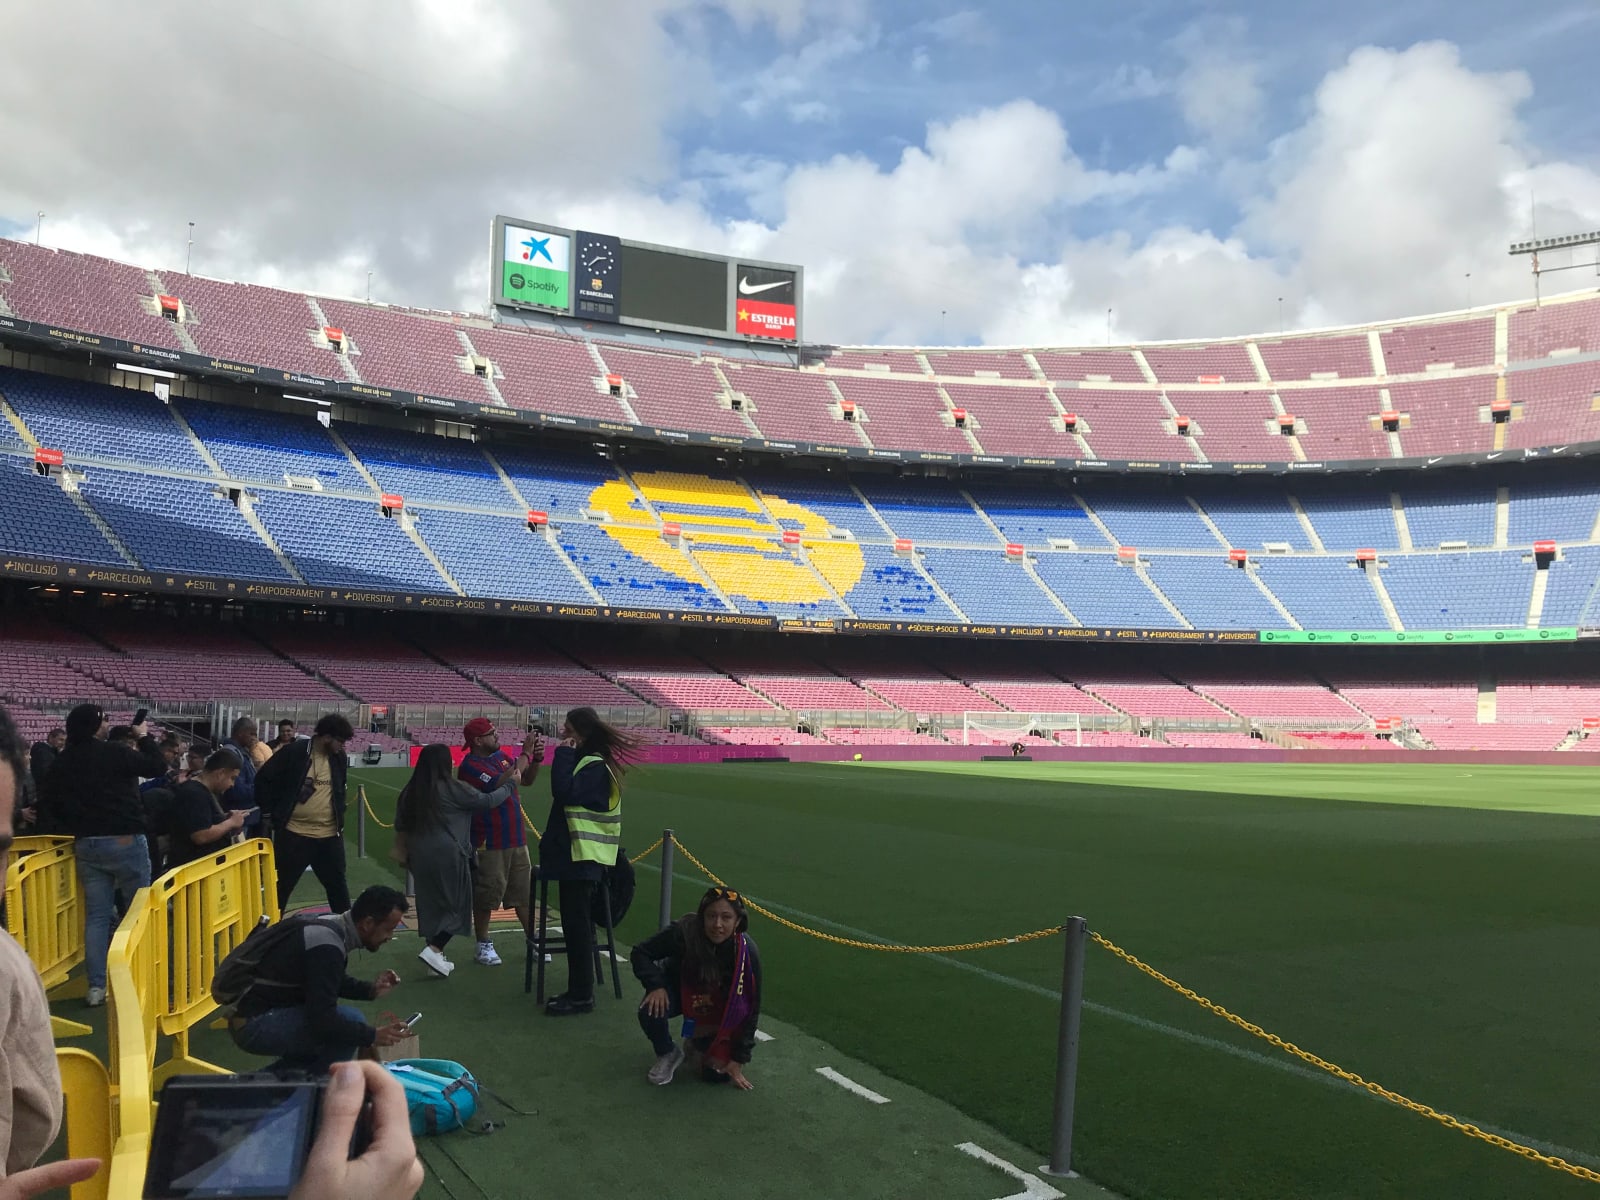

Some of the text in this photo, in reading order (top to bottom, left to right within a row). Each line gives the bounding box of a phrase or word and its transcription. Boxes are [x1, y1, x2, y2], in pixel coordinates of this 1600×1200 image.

[527, 279, 560, 294] Spotify
[586, 290, 614, 299] BARCELONA
[751, 313, 796, 327] ESTRELLA
[149, 350, 180, 360] BARCELONA
[298, 377, 325, 386] BARCELONA
[430, 399, 456, 408] BARCELONA
